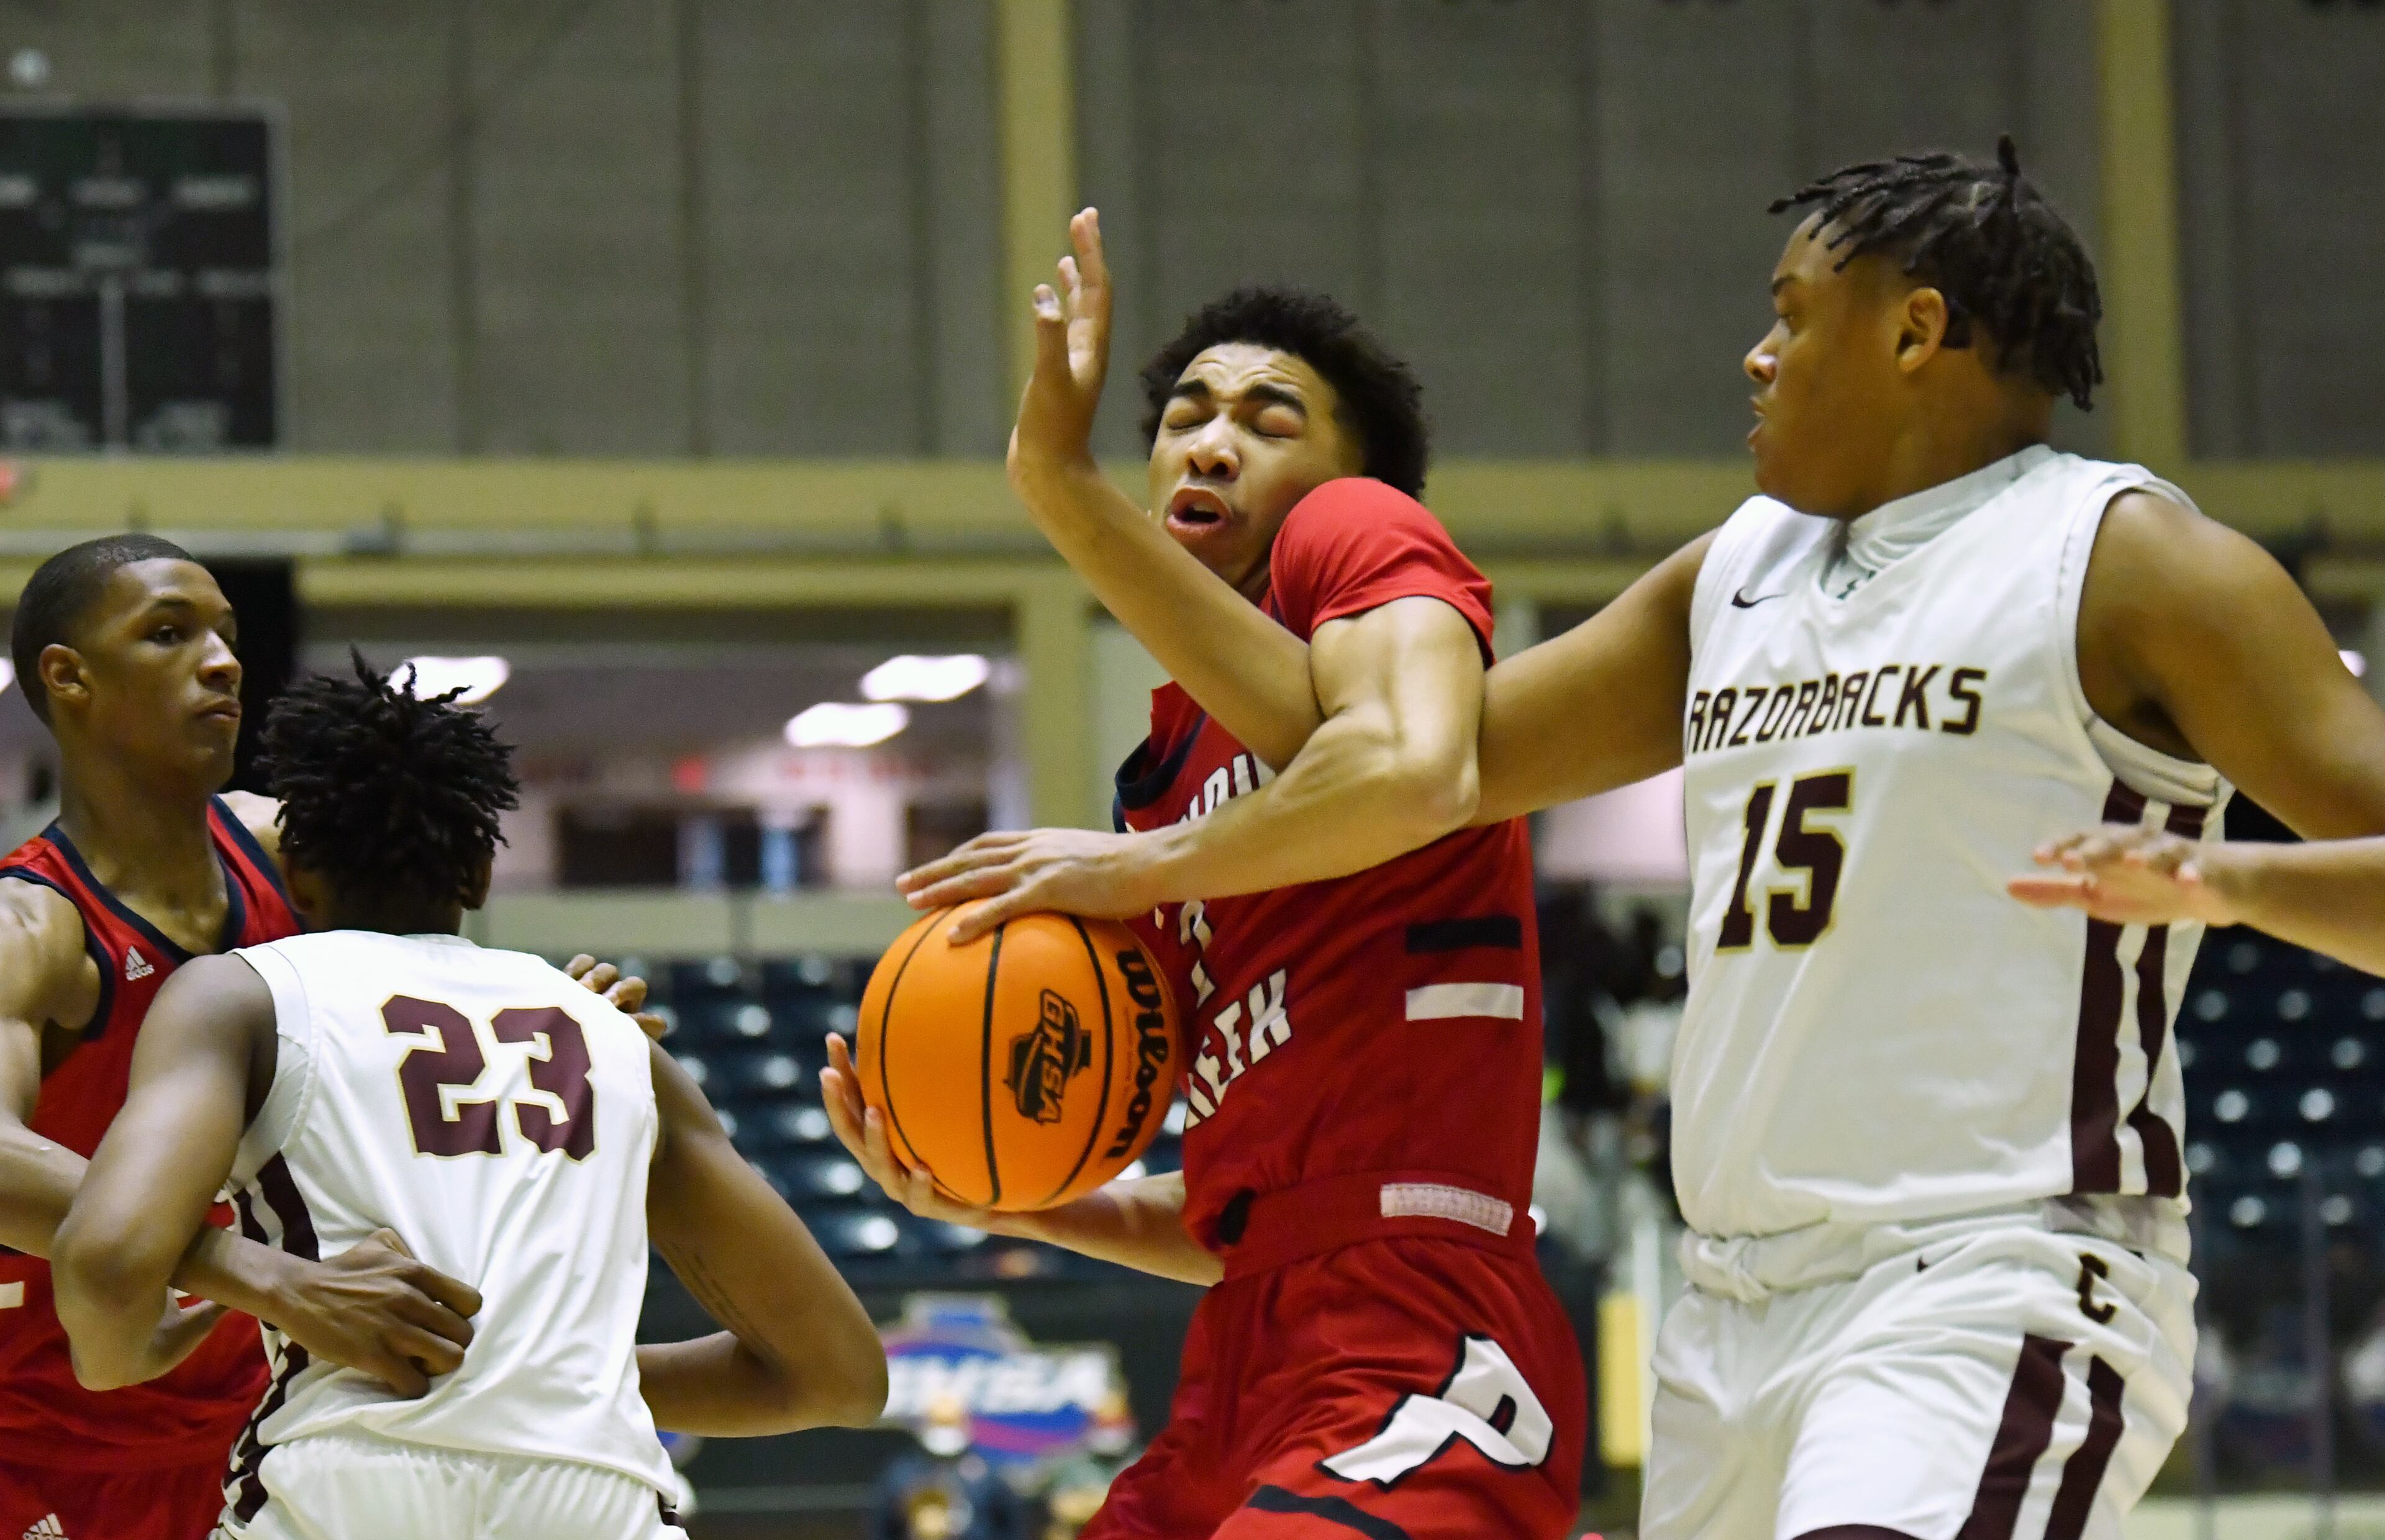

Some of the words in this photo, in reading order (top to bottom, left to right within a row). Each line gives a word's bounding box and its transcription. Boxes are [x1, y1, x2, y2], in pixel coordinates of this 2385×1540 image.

[1687, 664, 1986, 754] RAZORBACKS
[1714, 765, 1856, 955] 15
[376, 992, 598, 1166] 23
[1035, 989, 1066, 1124] GHSA
[2076, 1251, 2118, 1326] C
